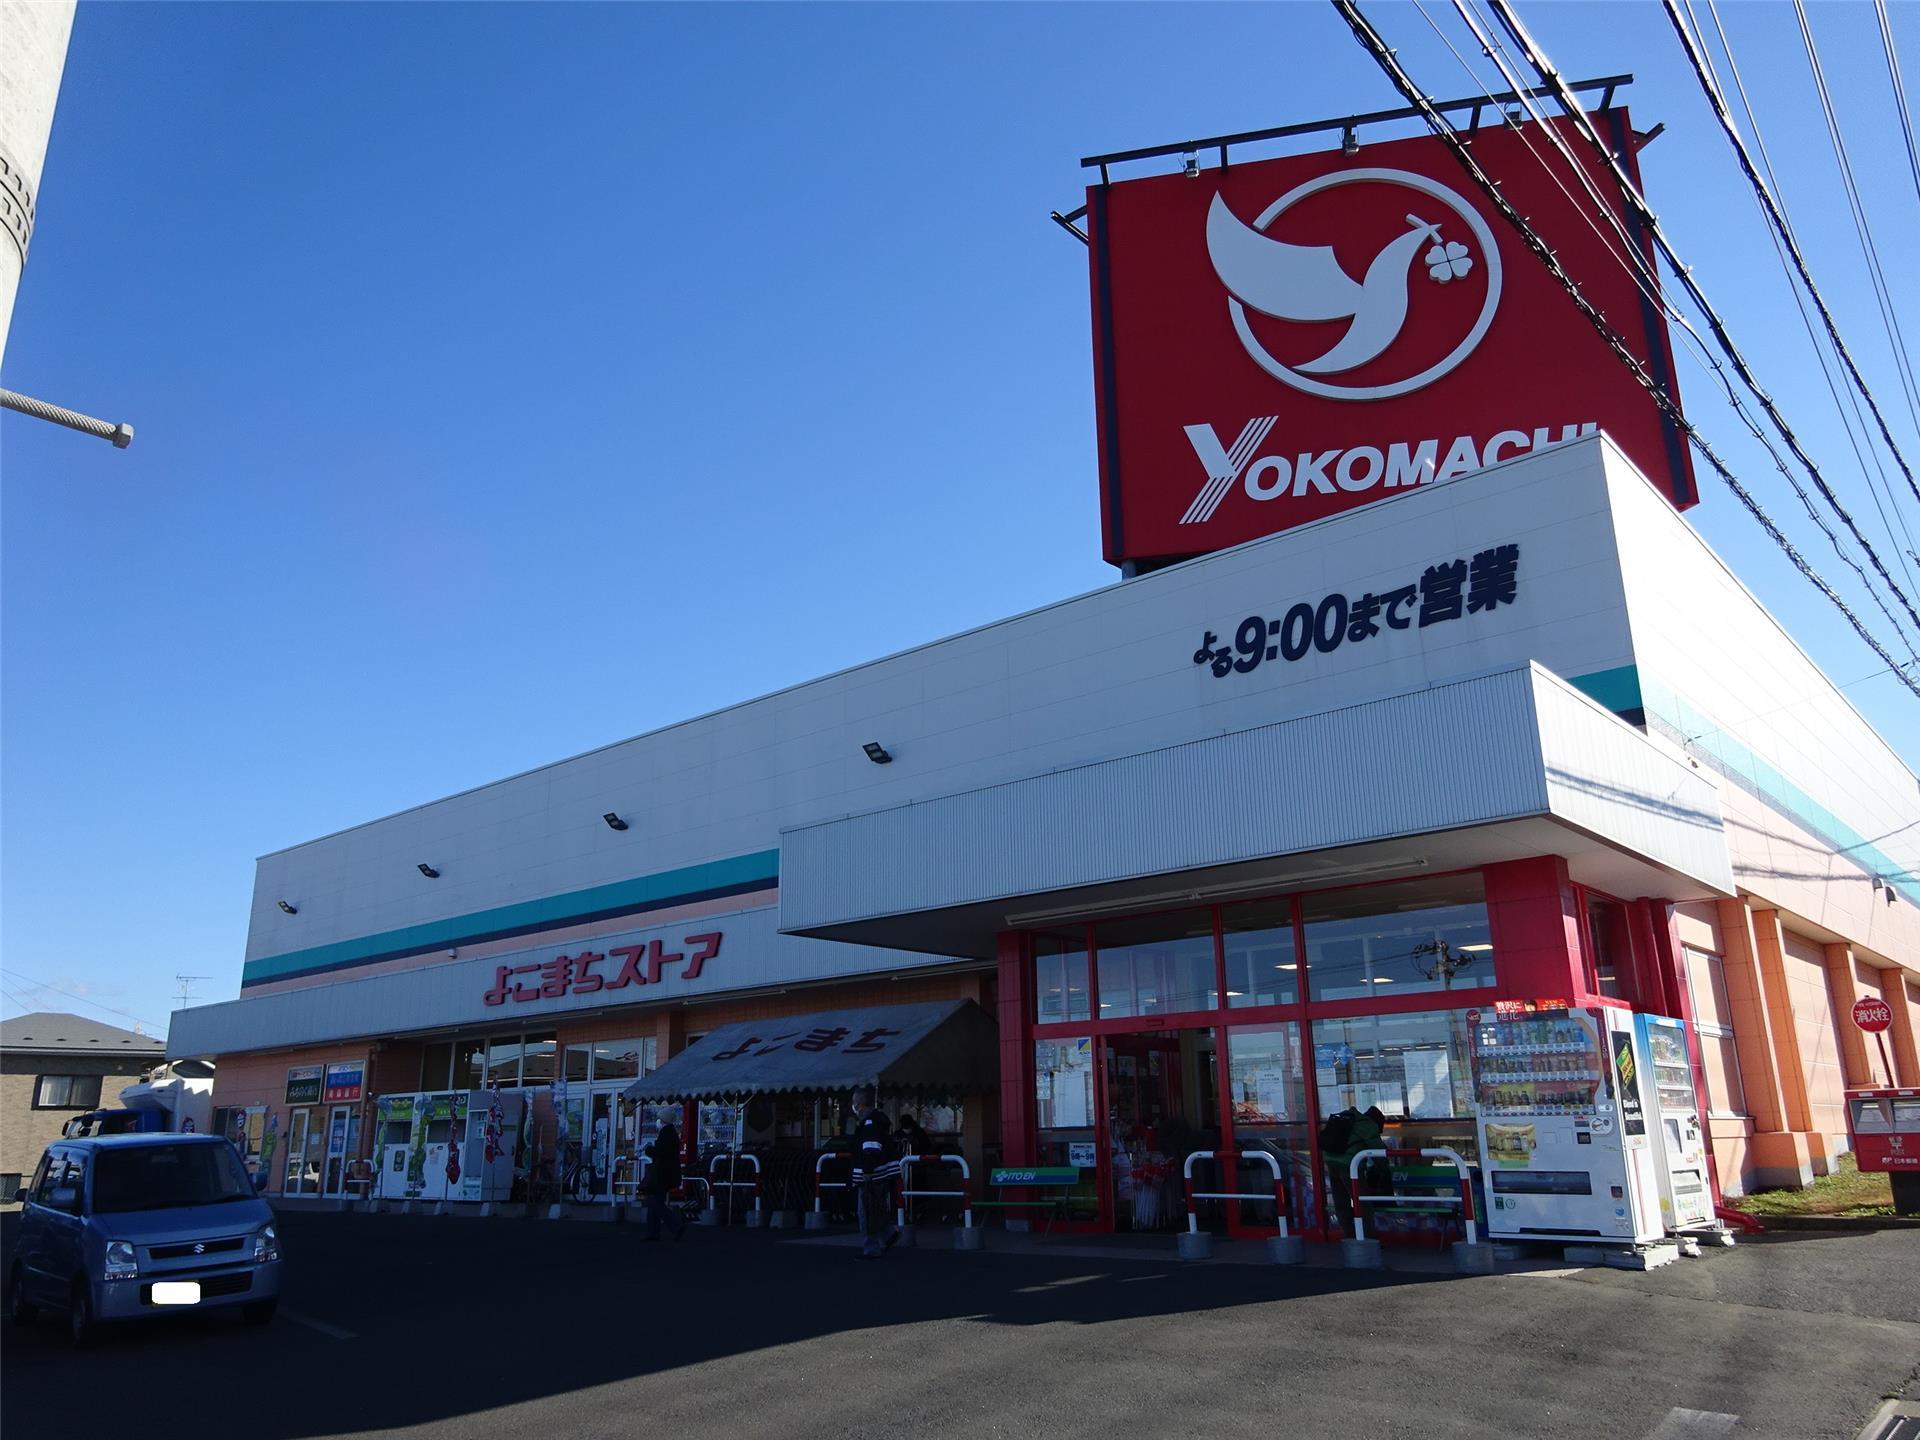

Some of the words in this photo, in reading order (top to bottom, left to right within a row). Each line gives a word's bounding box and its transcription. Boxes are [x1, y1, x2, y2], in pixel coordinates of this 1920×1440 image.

[1193, 543, 1520, 678] よる9:00まで営業
[483, 931, 723, 1007] よこまちストア
[1855, 1007, 1889, 1024] 消火栓
[711, 1027, 900, 1062] よこまち
